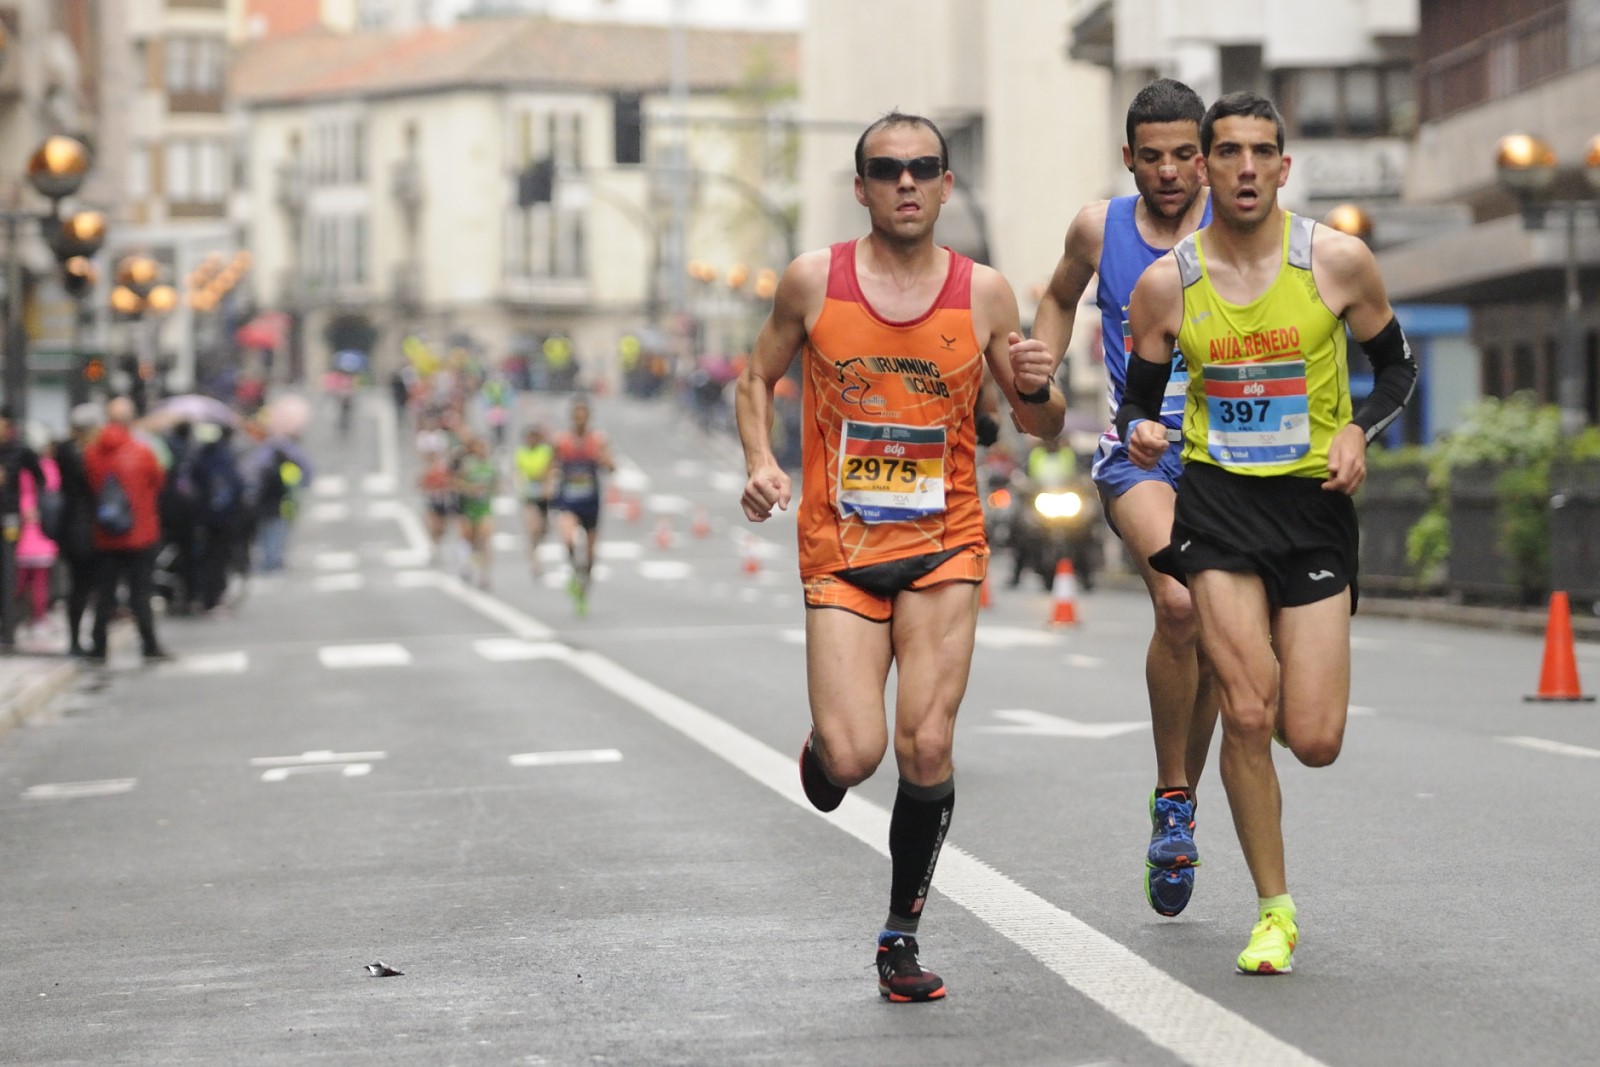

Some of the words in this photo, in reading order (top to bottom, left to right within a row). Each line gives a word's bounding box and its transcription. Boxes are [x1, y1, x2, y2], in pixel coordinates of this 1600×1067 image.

[1243, 326, 1300, 357] RENEDO
[877, 357, 941, 378] RUNNING
[914, 379, 949, 398] CLUB
[1243, 382, 1265, 396] edp
[1219, 399, 1271, 424] 397
[884, 443, 905, 457] edp
[846, 459, 917, 483] 2975
